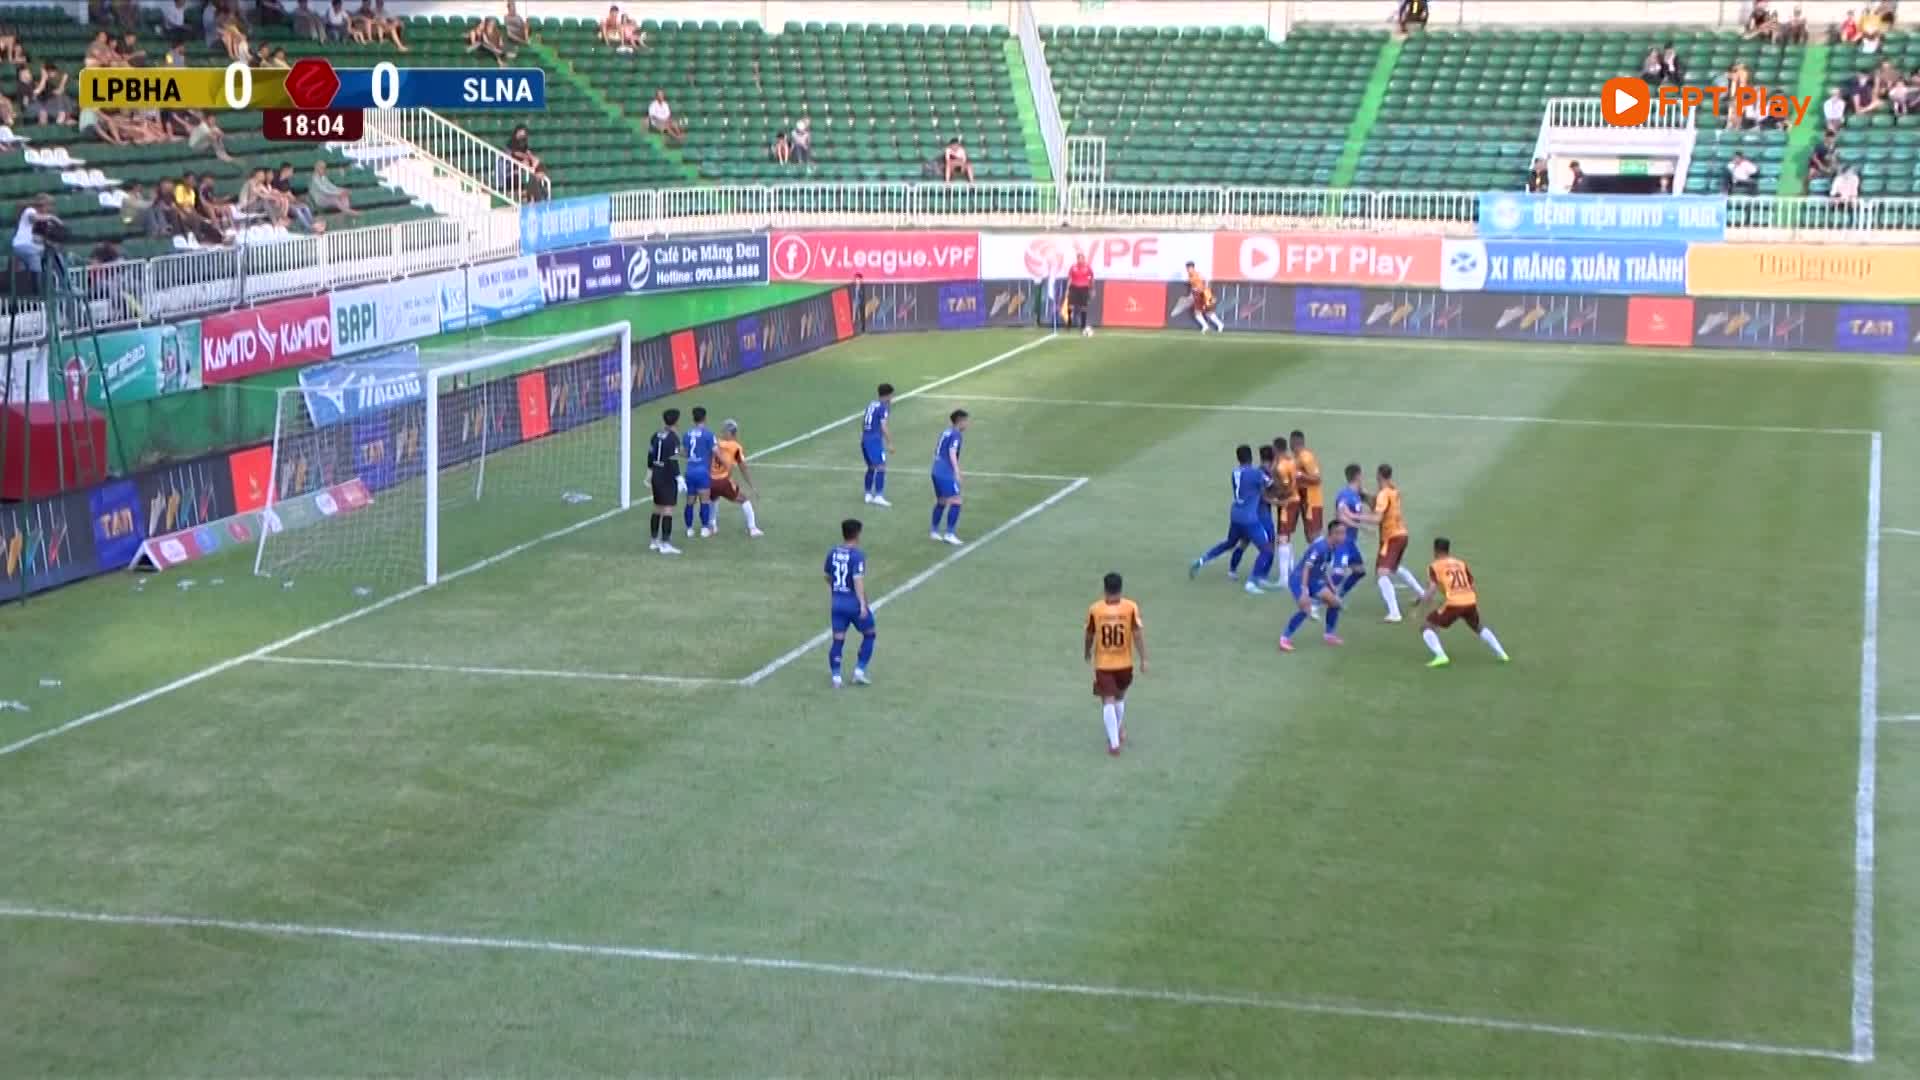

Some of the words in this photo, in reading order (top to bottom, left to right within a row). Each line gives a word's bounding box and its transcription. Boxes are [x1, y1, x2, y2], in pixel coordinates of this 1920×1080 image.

[683, 246, 698, 262] De
[1286, 245, 1344, 273] FPT
[1349, 246, 1414, 281] Play
[1490, 254, 1508, 281] XI
[336, 300, 377, 345] BAPI
[203, 330, 257, 371] KAMITO
[280, 315, 330, 355] KAMITO
[1447, 568, 1468, 588] 20
[1101, 623, 1125, 649] 86
